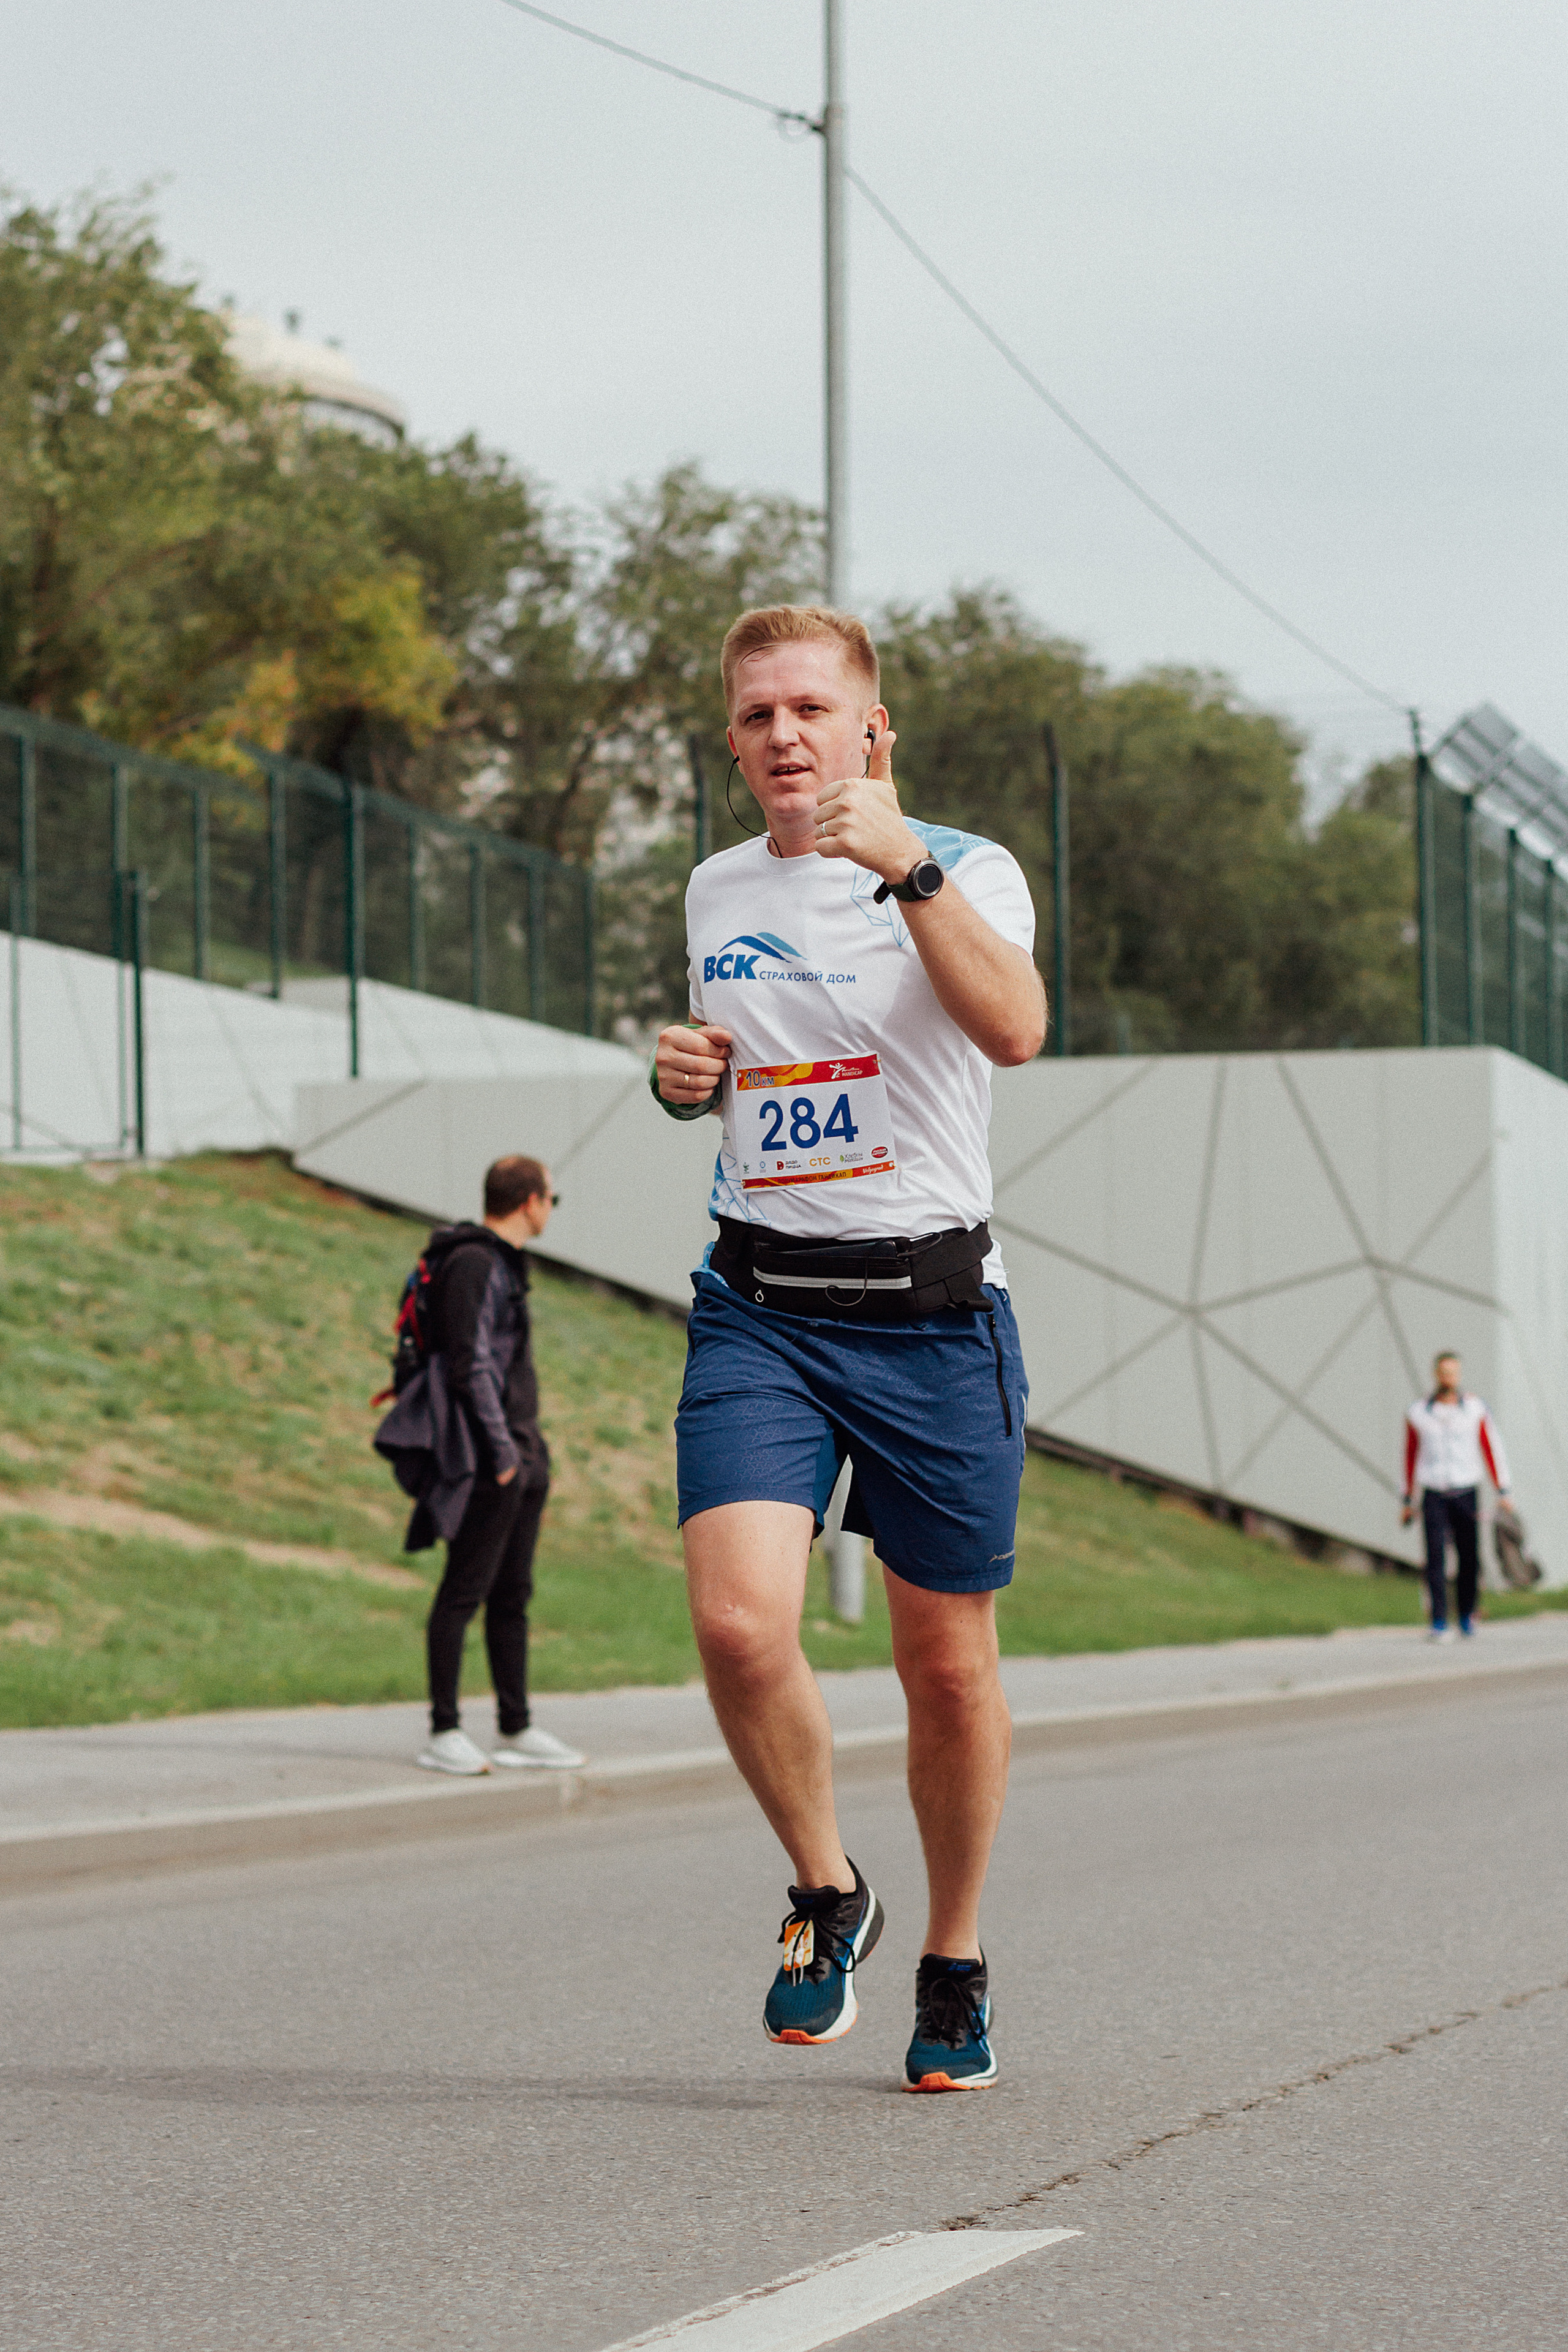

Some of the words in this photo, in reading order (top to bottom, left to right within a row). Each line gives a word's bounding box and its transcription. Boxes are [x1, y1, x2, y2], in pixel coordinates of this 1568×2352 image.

[704, 953, 761, 983] ВСК
[760, 971, 823, 981] СТРАХОВОЙ
[826, 974, 856, 984] ДОМ
[745, 1070, 761, 1087] 10
[759, 1093, 859, 1152] 284
